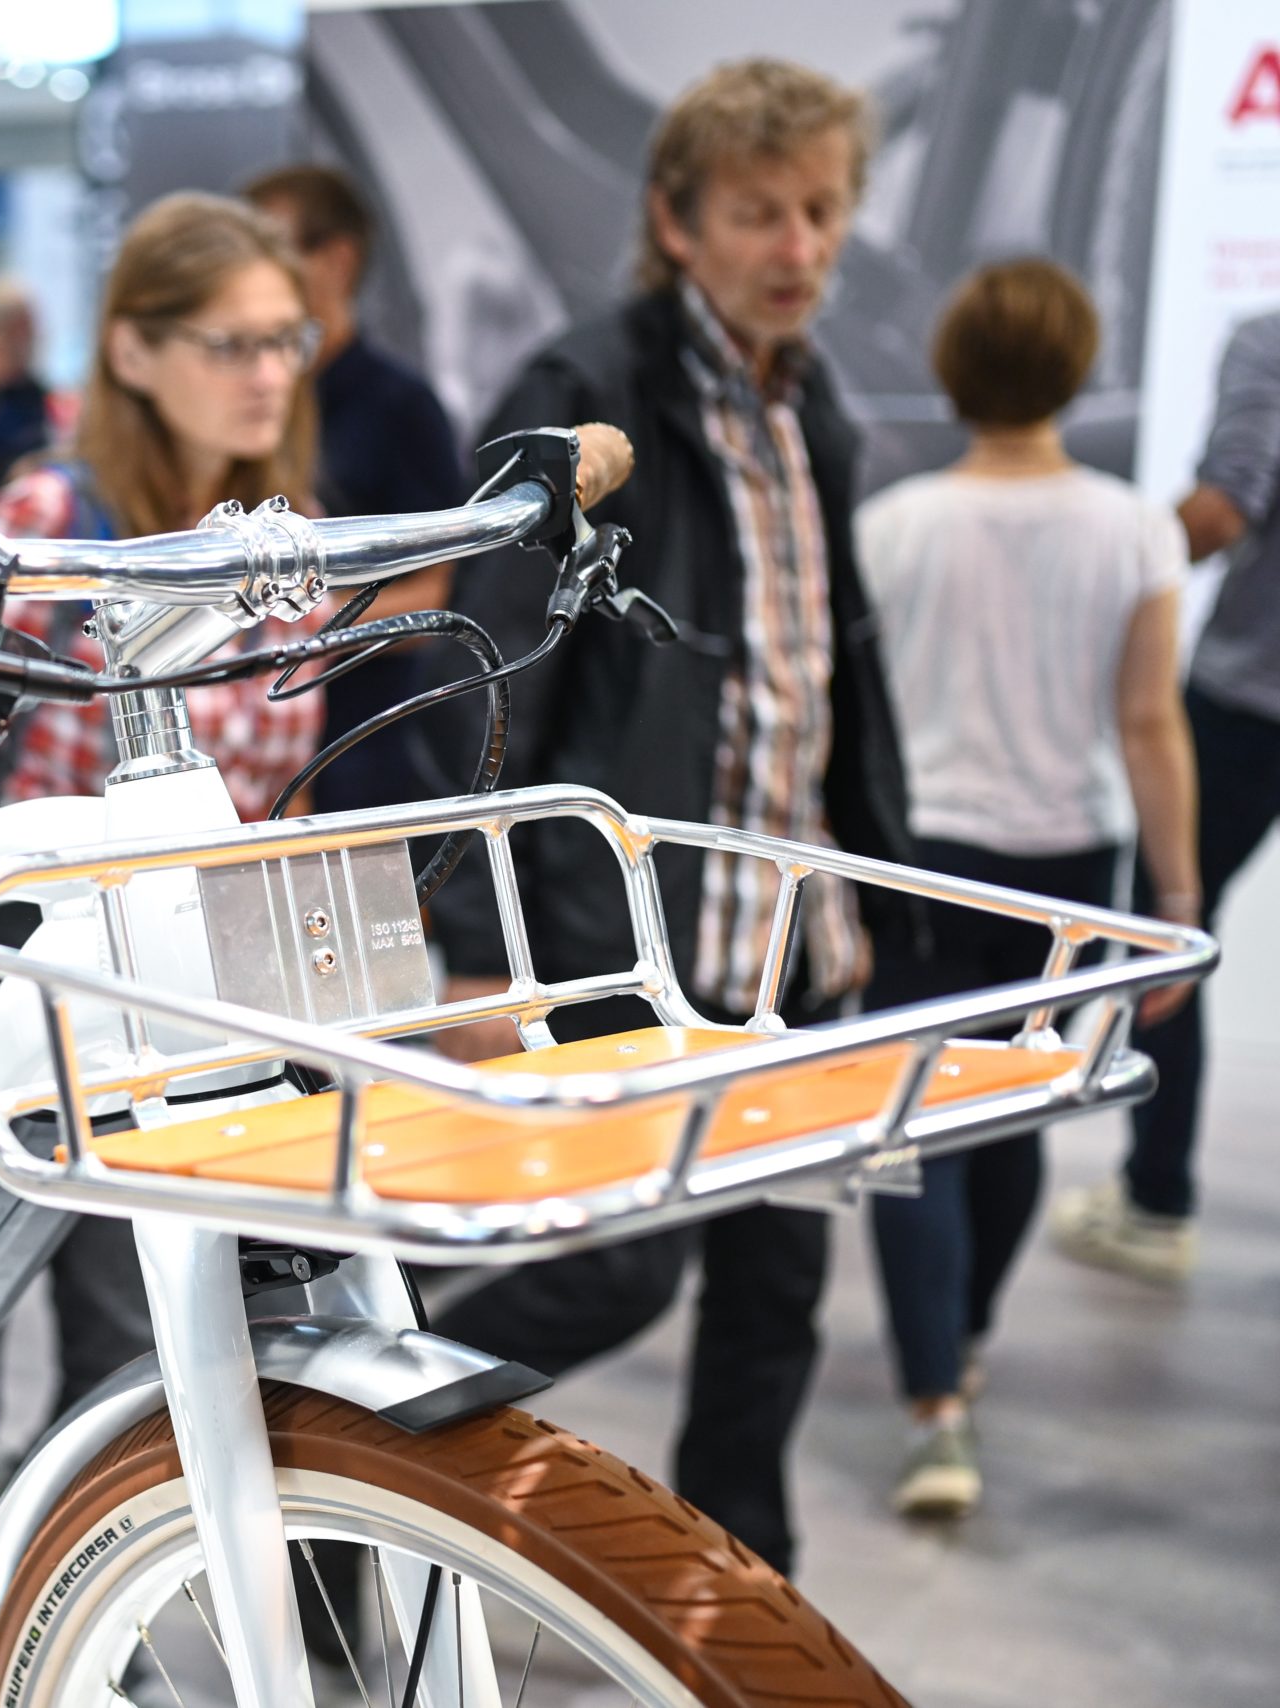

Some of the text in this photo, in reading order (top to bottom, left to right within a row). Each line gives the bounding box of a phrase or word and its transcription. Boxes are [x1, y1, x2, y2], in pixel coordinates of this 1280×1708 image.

[371, 918, 420, 937] ISO 11243
[371, 937, 395, 950] MAX
[5, 1527, 119, 1708] SUPERO INTERCORSA
